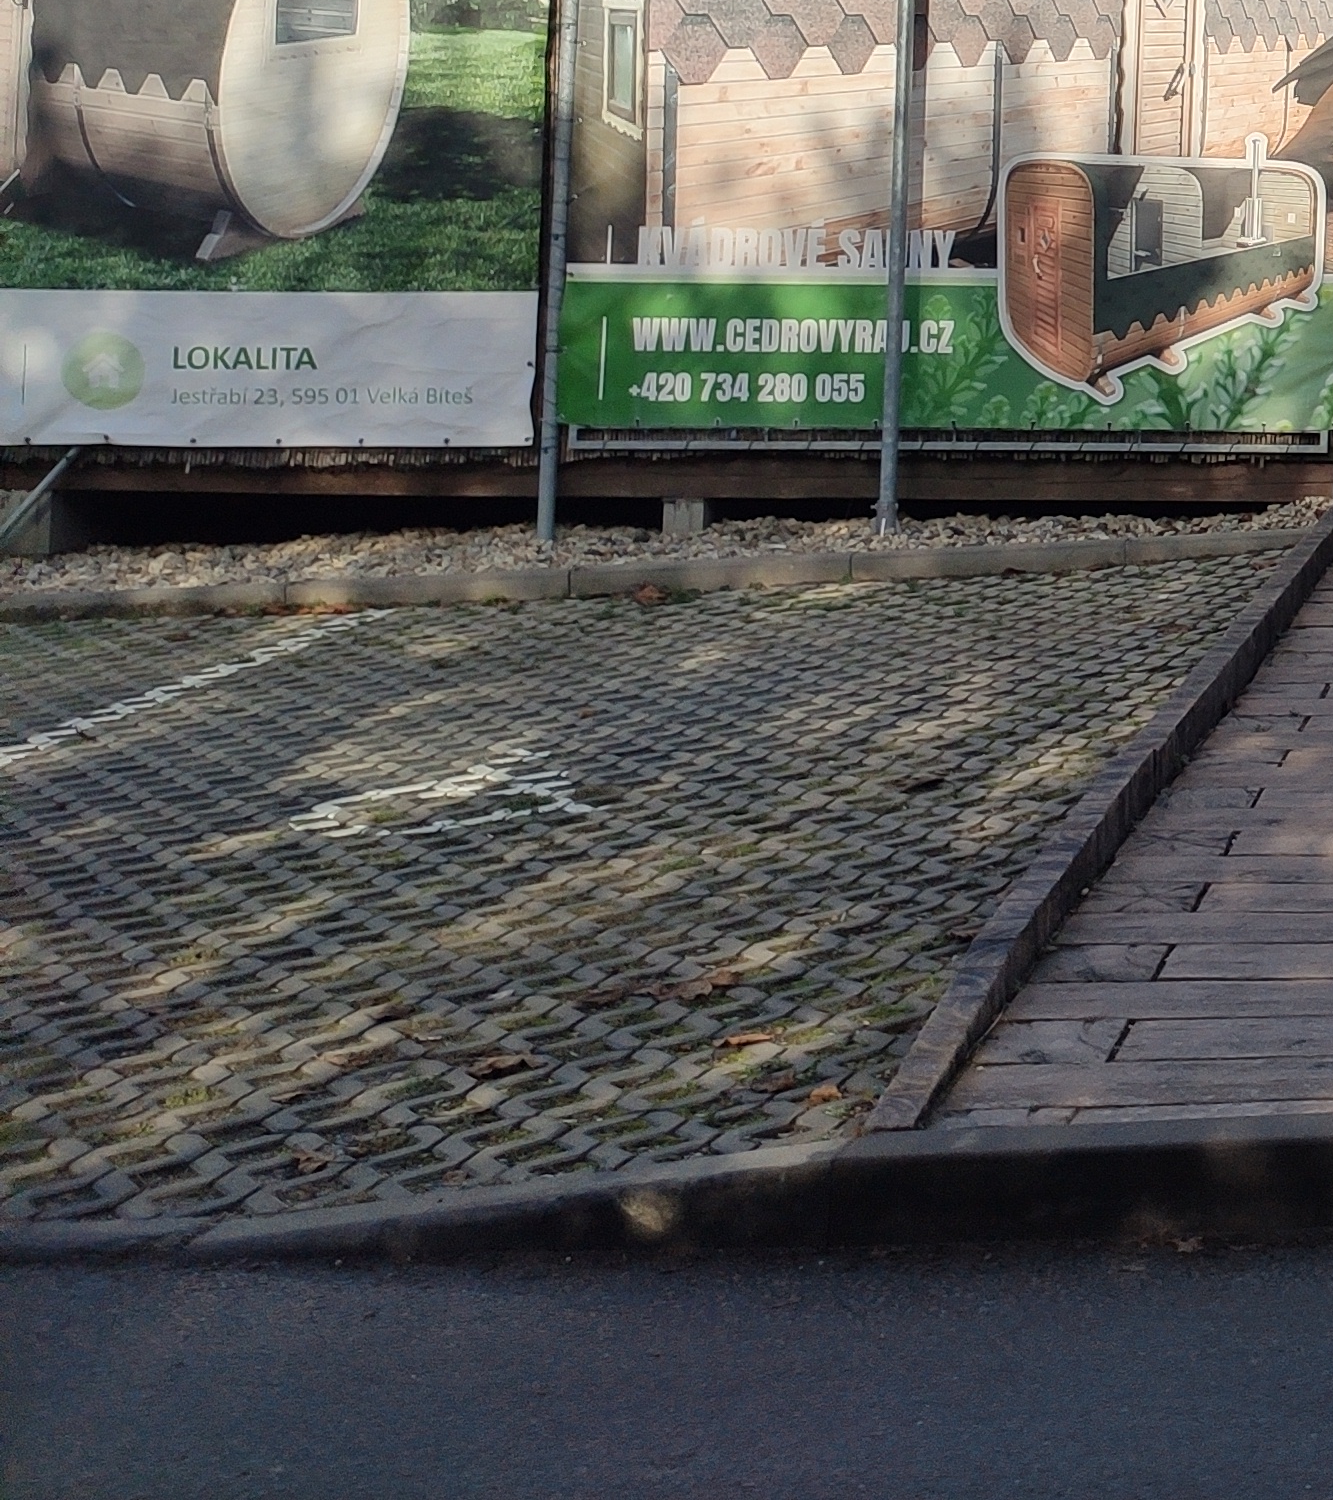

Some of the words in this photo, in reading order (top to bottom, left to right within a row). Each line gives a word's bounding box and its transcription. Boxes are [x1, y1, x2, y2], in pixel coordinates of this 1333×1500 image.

[638, 215, 827, 268] KVÁDROVÉ
[838, 228, 957, 269] SANY
[172, 346, 318, 371] LOKALITA
[171, 387, 247, 406] Jestřabí
[253, 387, 286, 408] 23,
[291, 387, 330, 405] 595
[335, 387, 360, 404] 01
[367, 386, 419, 405] Velká
[426, 386, 474, 406] Bíteš
[628, 371, 692, 402] +420
[700, 372, 750, 402] 734
[757, 373, 808, 402] 280
[815, 373, 865, 402] 055
